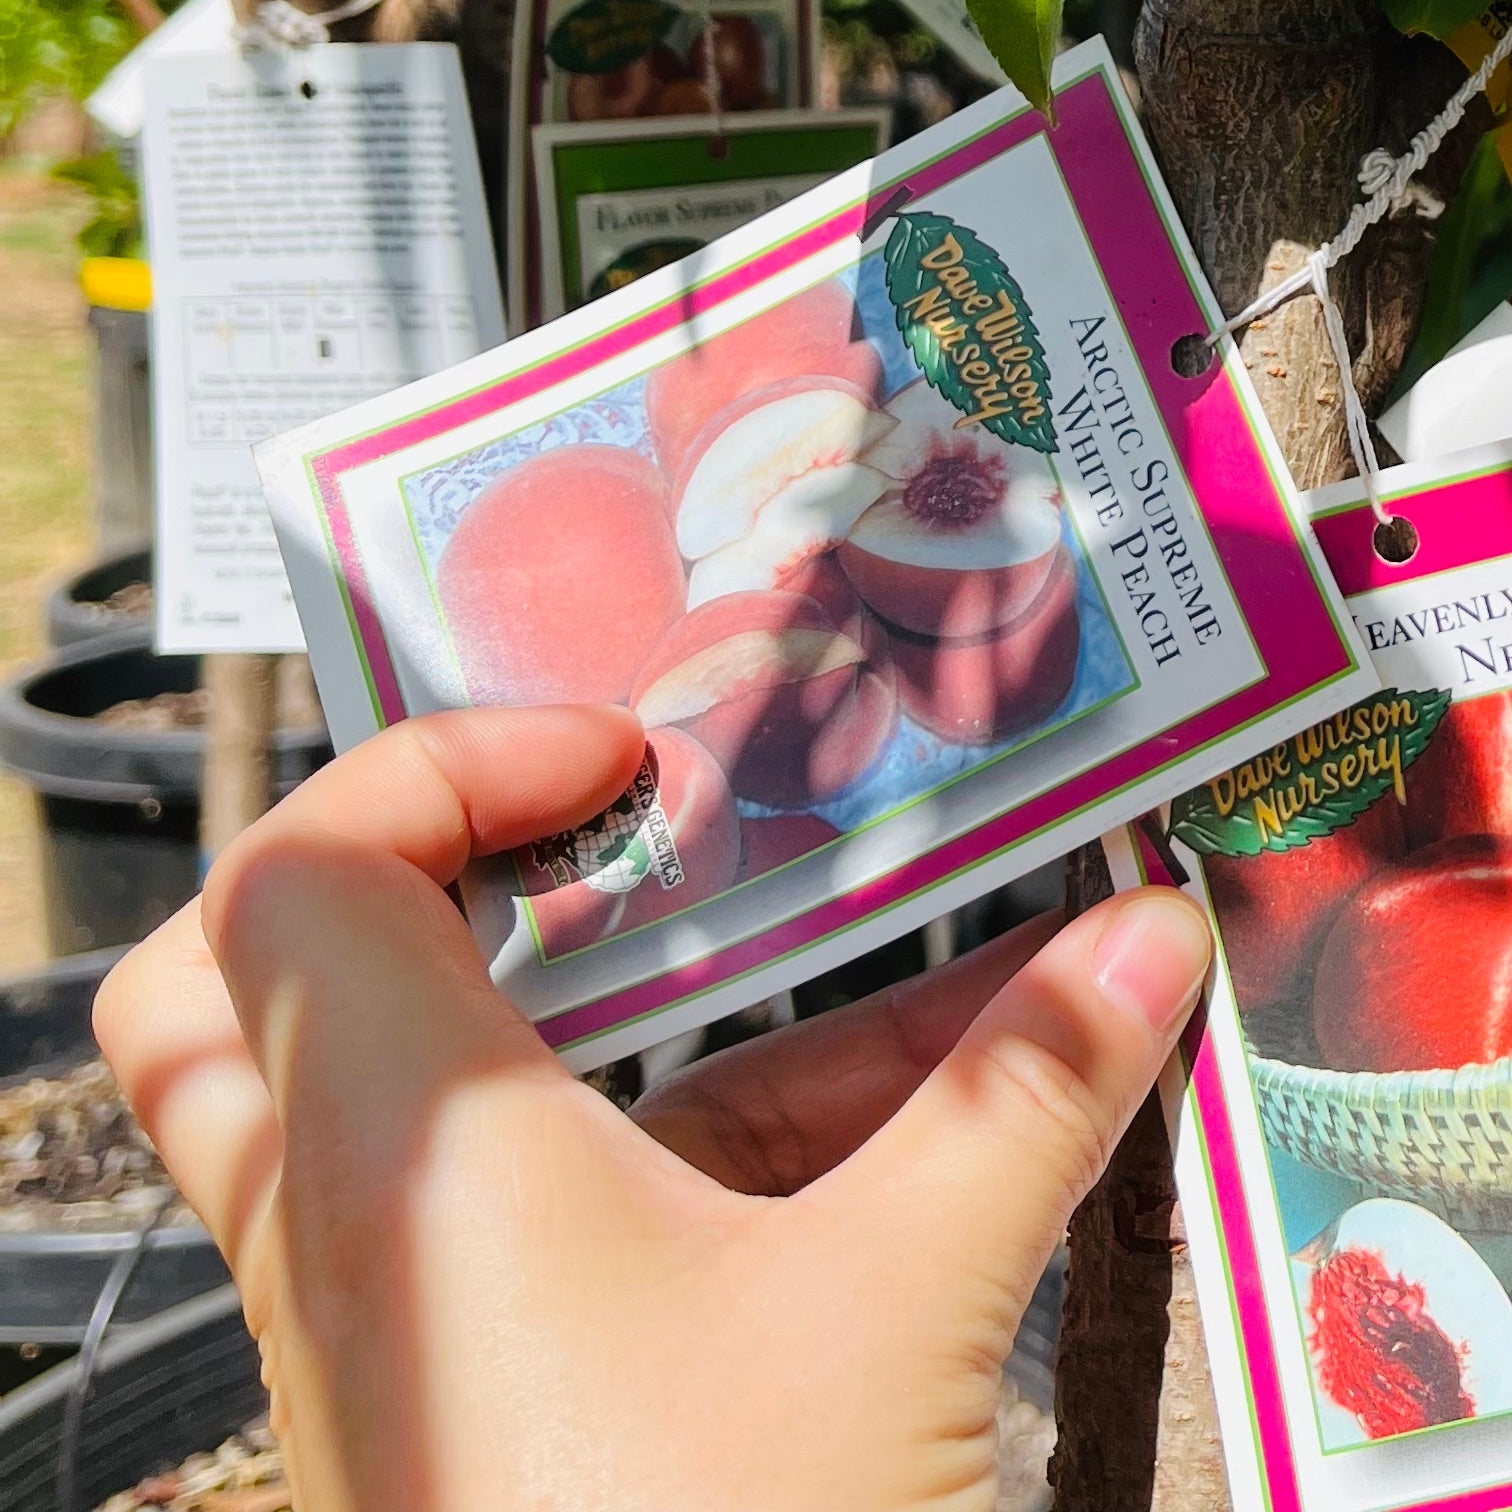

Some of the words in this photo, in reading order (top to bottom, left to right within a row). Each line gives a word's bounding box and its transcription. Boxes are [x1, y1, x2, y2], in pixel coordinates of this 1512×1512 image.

[903, 288, 1013, 431] Nursery
[919, 233, 994, 316] Dave
[976, 289, 1045, 426] Wilson
[1056, 385, 1124, 528] WHITE
[1110, 527, 1182, 668] PEACH
[1068, 313, 1144, 456] ARCTIC
[1130, 458, 1223, 646] SUPREME
[1210, 743, 1291, 818] Dave
[1295, 694, 1420, 763] Wilson
[1254, 734, 1408, 844] Nursery
[648, 808, 684, 888] GENETICS
